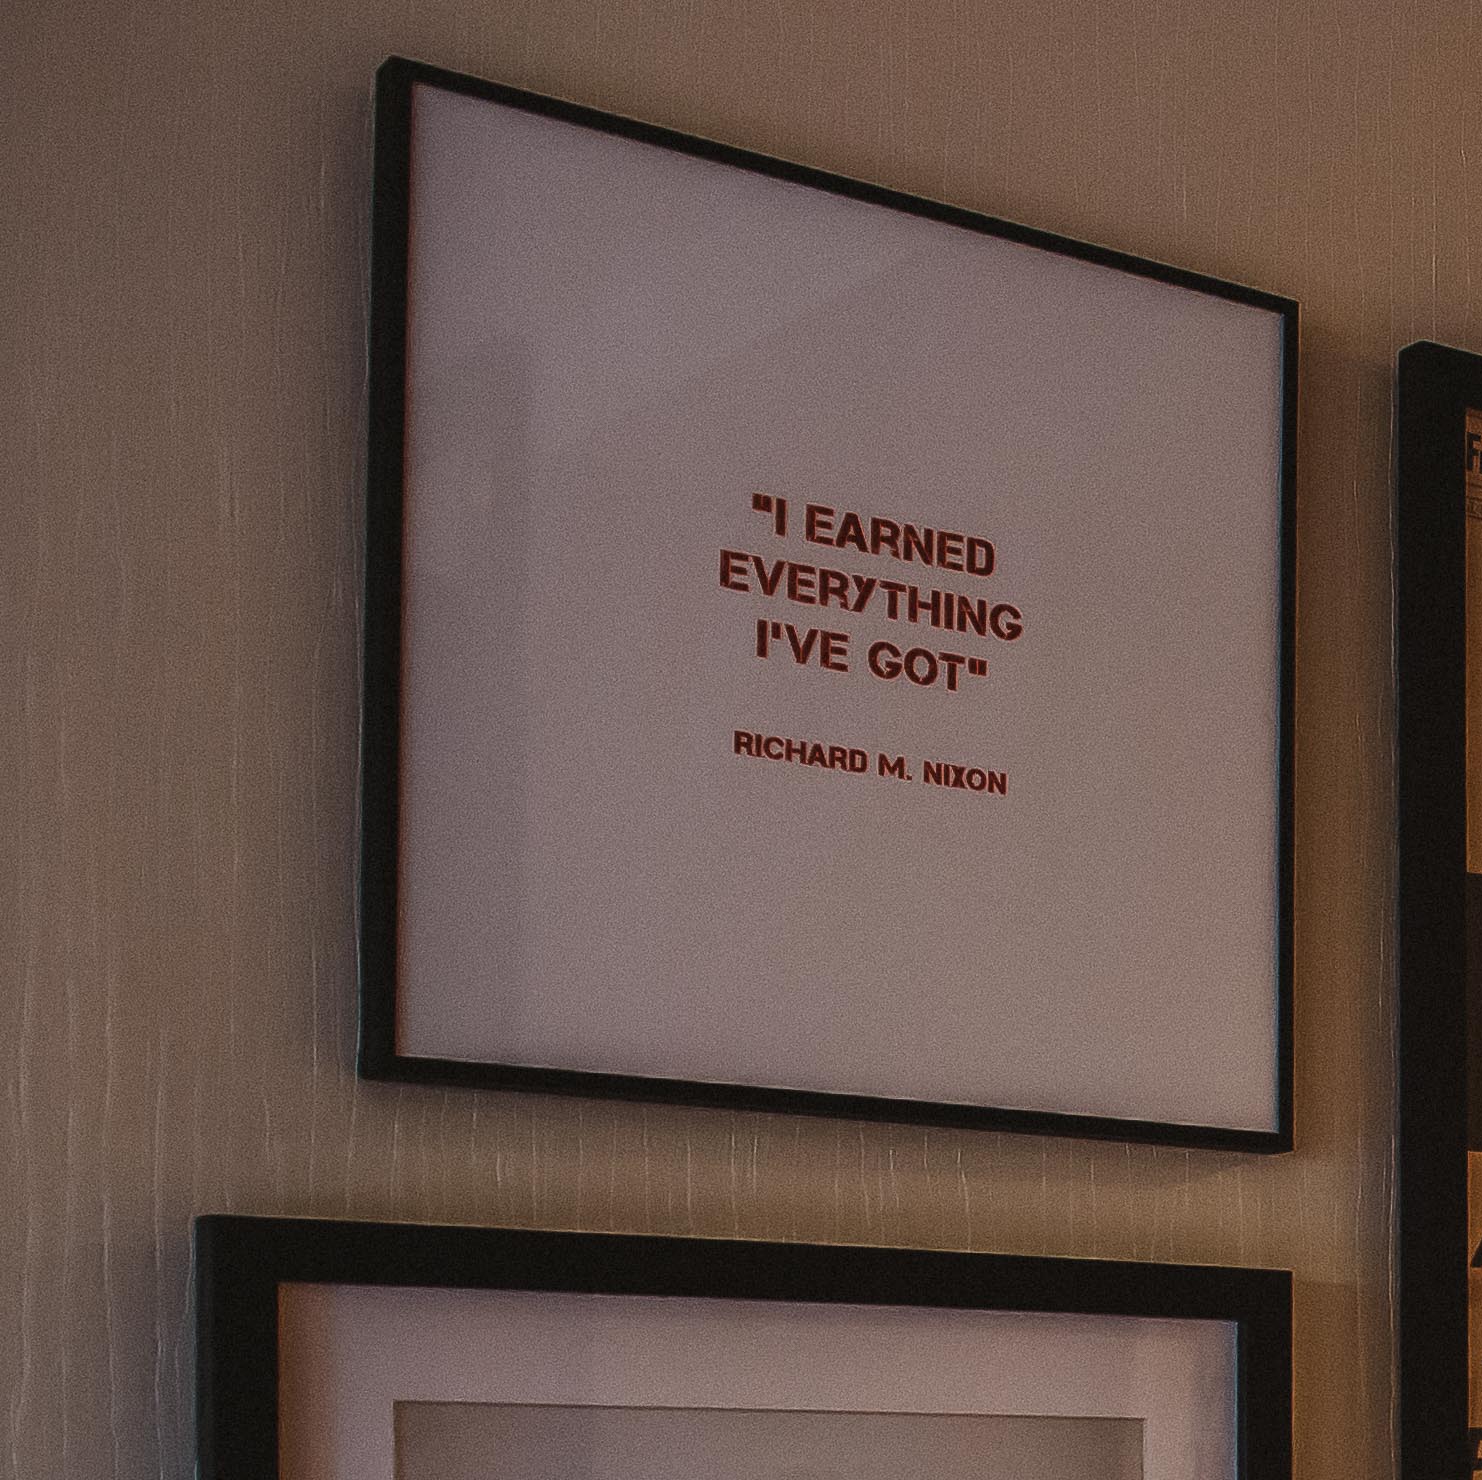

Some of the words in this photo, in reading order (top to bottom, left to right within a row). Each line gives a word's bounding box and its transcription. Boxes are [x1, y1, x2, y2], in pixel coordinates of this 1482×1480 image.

[752, 492, 787, 537] "I
[806, 504, 995, 577] EARNED
[720, 549, 1023, 641] EVERYTHING
[757, 620, 849, 672] I'VE
[868, 641, 988, 691] GOT"
[734, 730, 867, 773] RICHARD
[878, 754, 912, 780] M.
[924, 761, 1007, 795] NIXON
